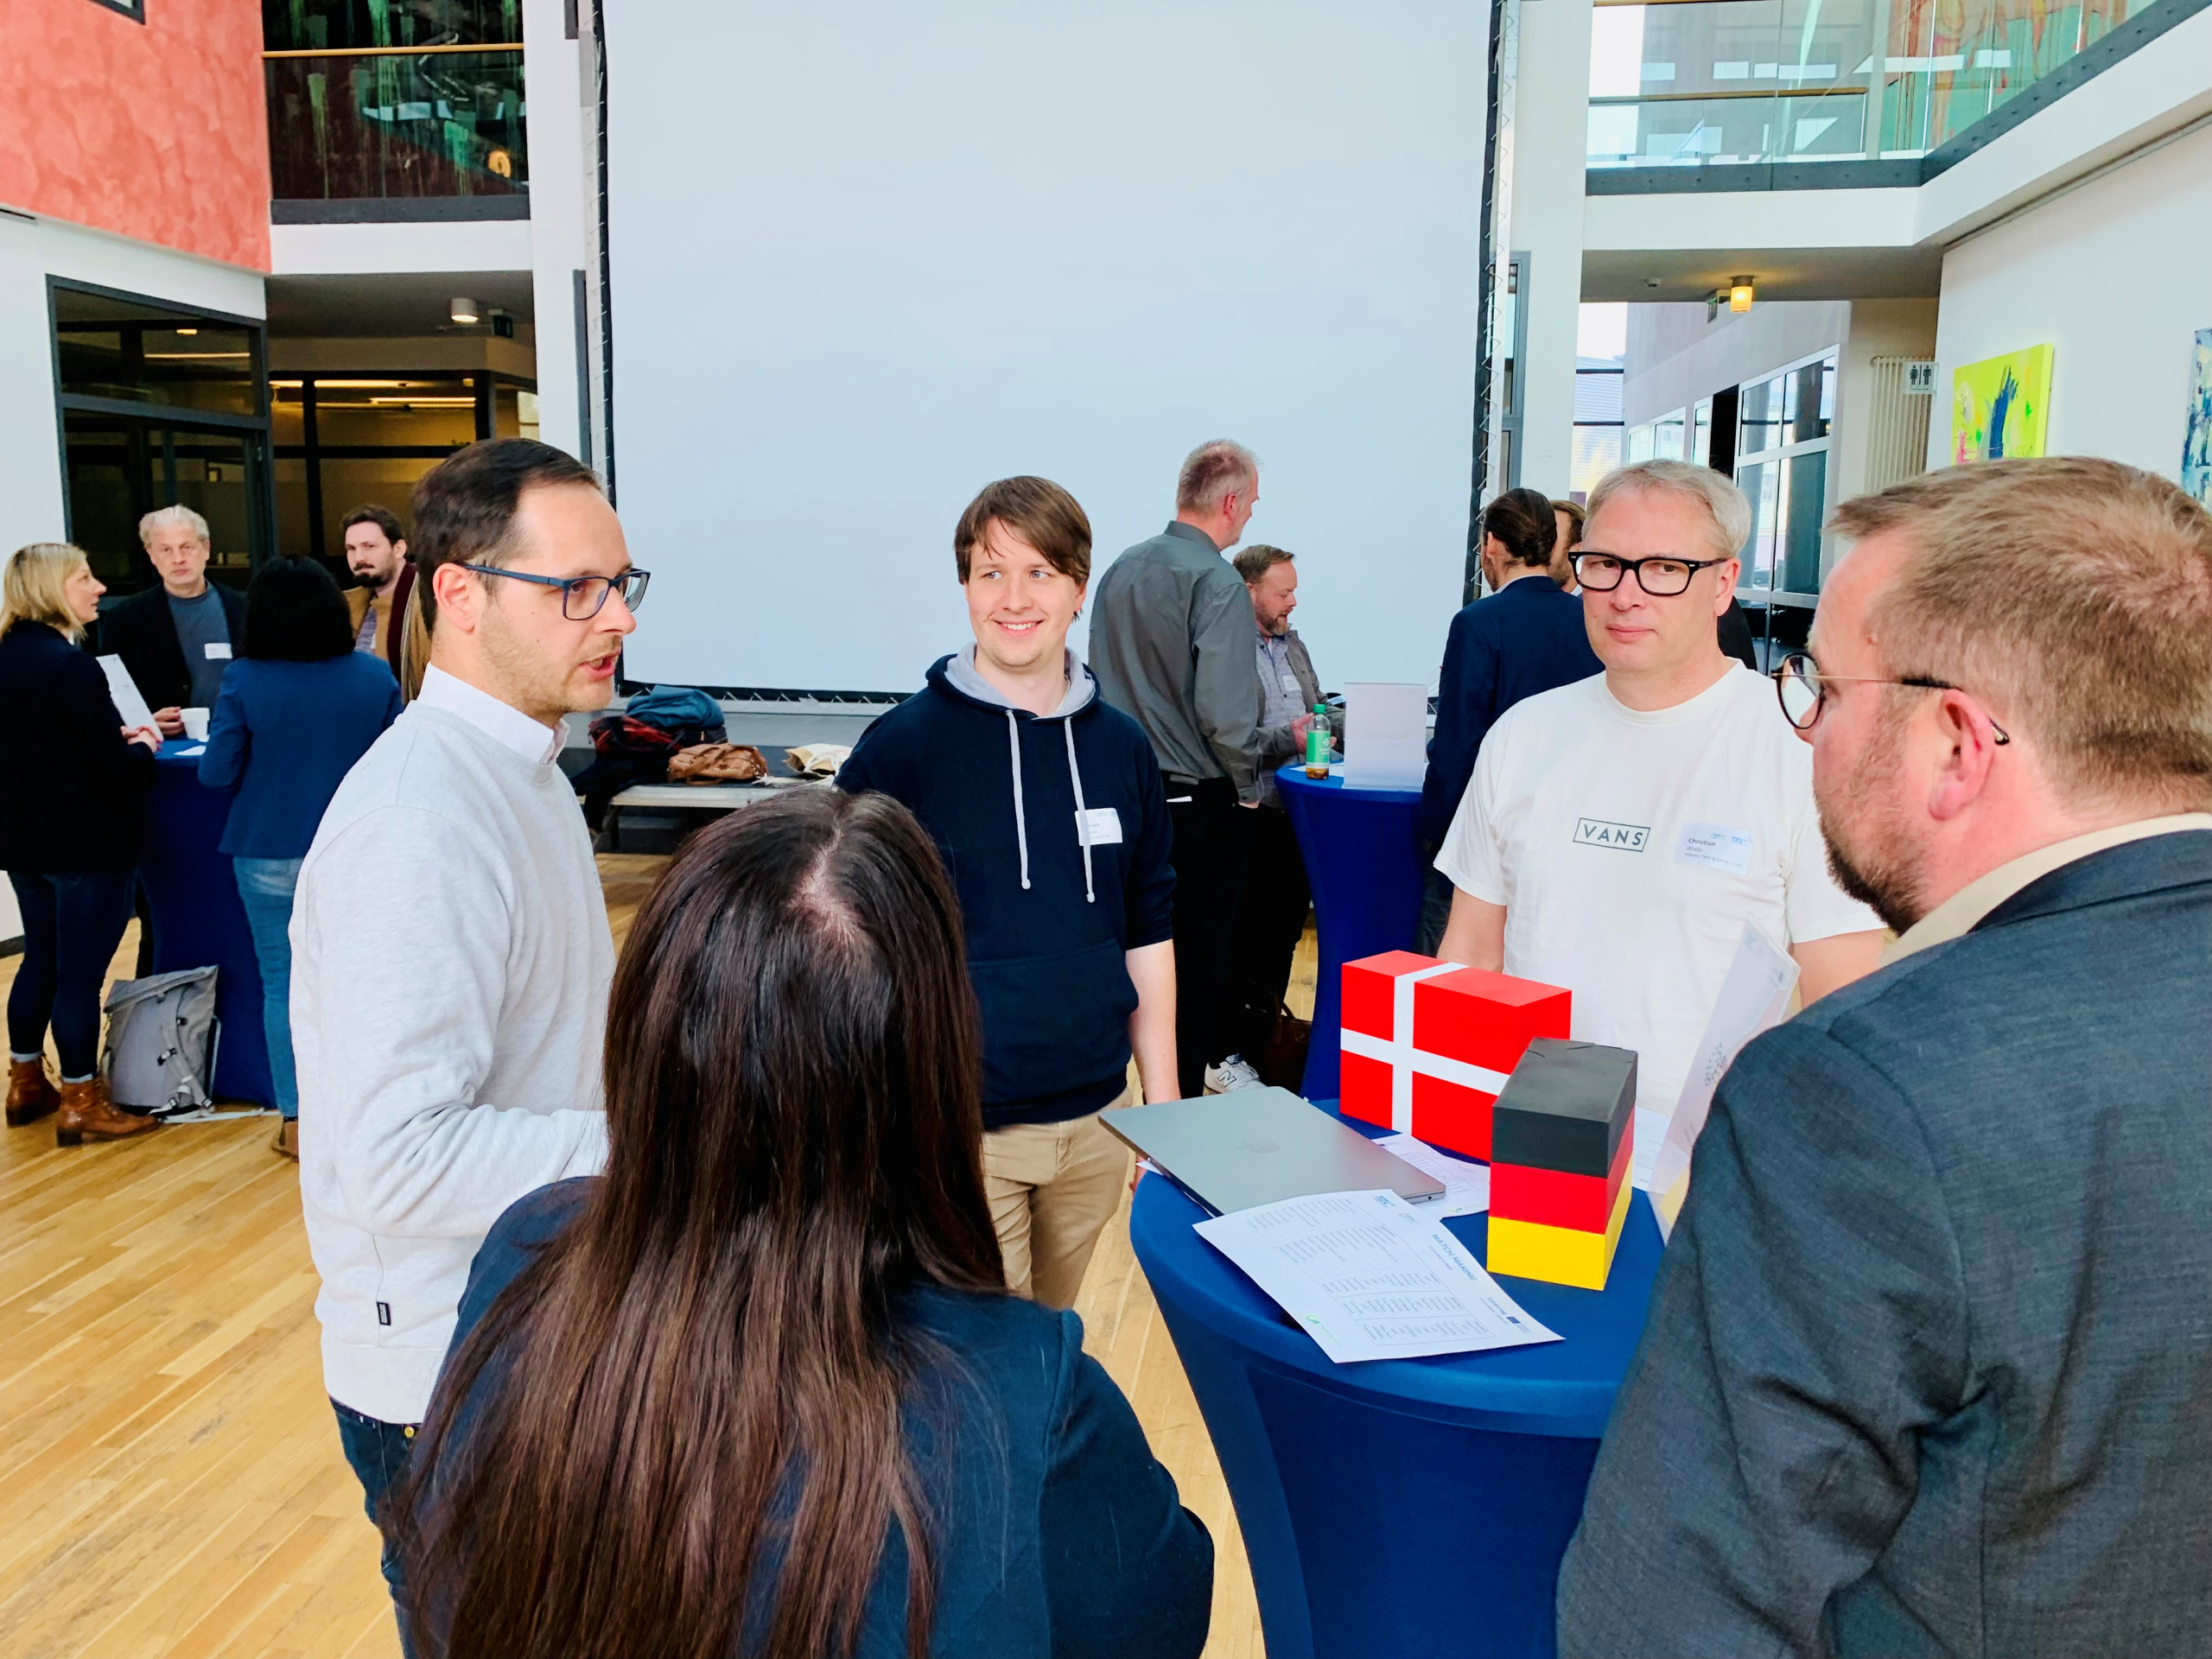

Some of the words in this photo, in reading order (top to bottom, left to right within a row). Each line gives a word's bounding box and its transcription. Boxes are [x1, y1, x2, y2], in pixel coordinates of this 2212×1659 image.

[1583, 823, 1643, 846] VANS
[1688, 837, 1716, 847] Christian
[1431, 1234, 1456, 1255] MATCH
[1451, 1256, 1478, 1281] MAKING
